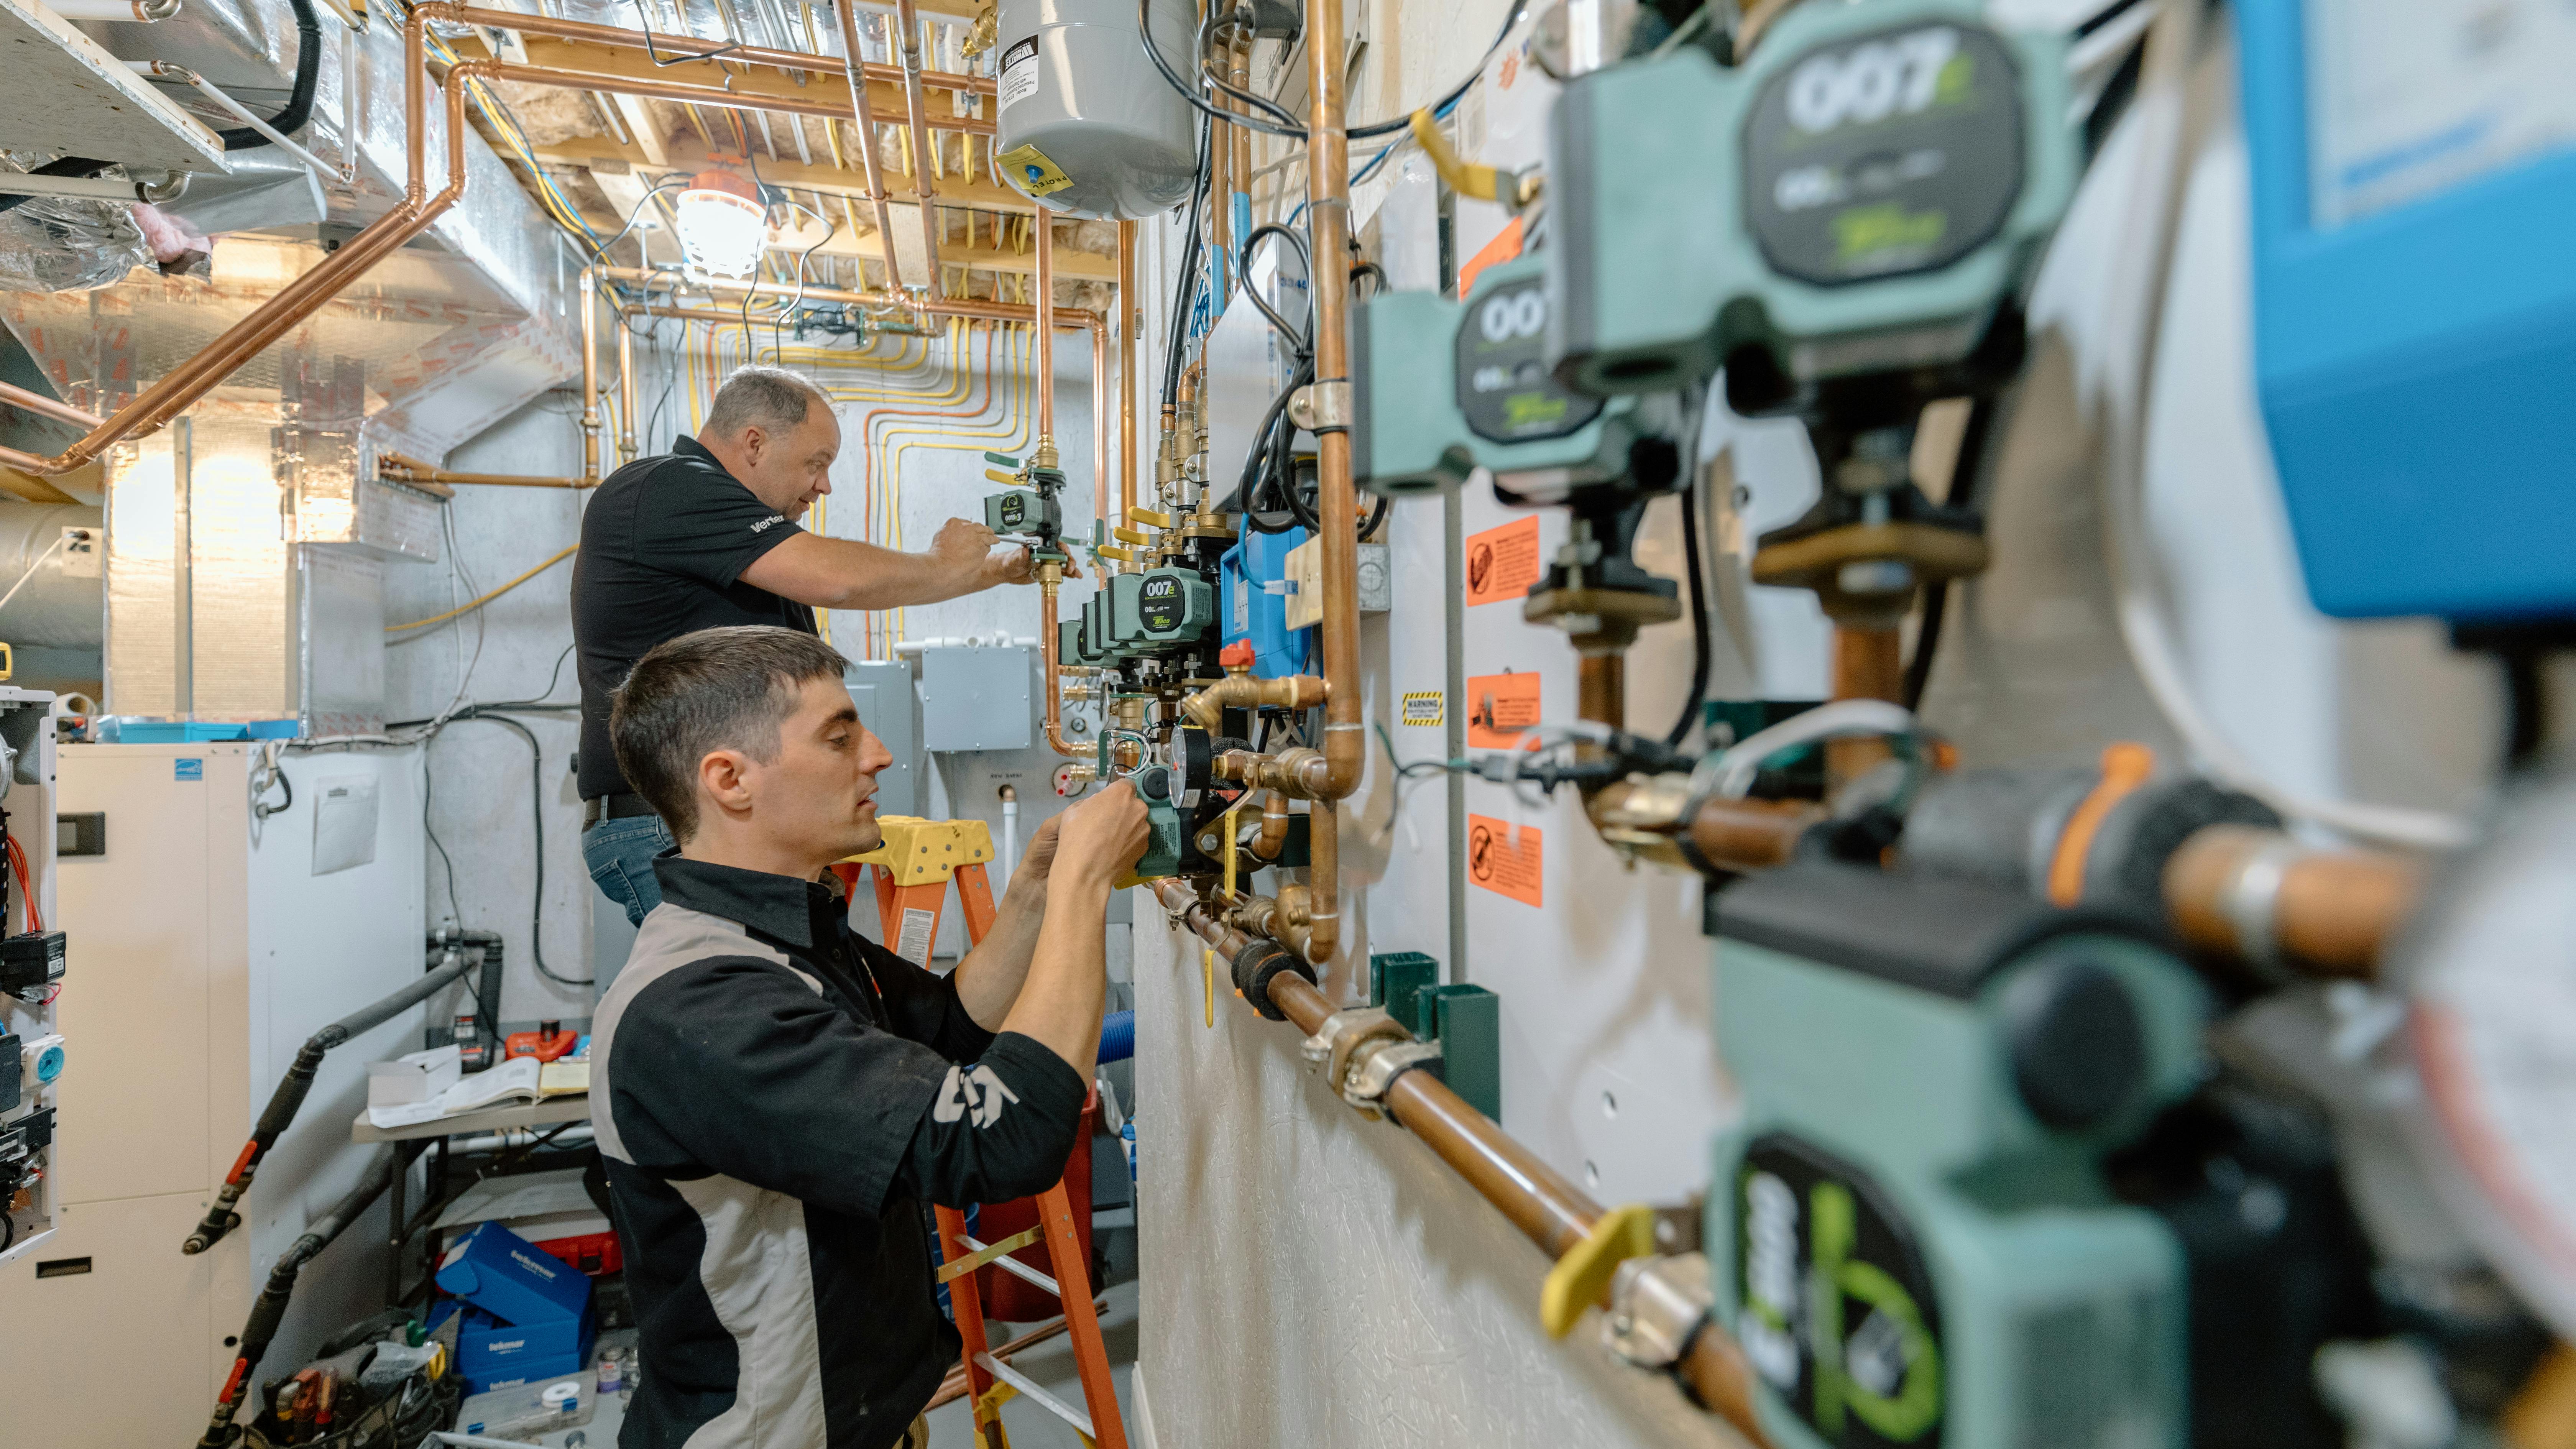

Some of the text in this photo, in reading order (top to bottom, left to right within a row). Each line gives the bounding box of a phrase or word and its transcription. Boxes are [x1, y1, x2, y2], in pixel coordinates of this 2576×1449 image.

[1016, 87, 1027, 96] Model
[749, 515, 785, 533] Vertex
[1153, 616, 1170, 624] Taco
[1407, 700, 1438, 708] WARNING
